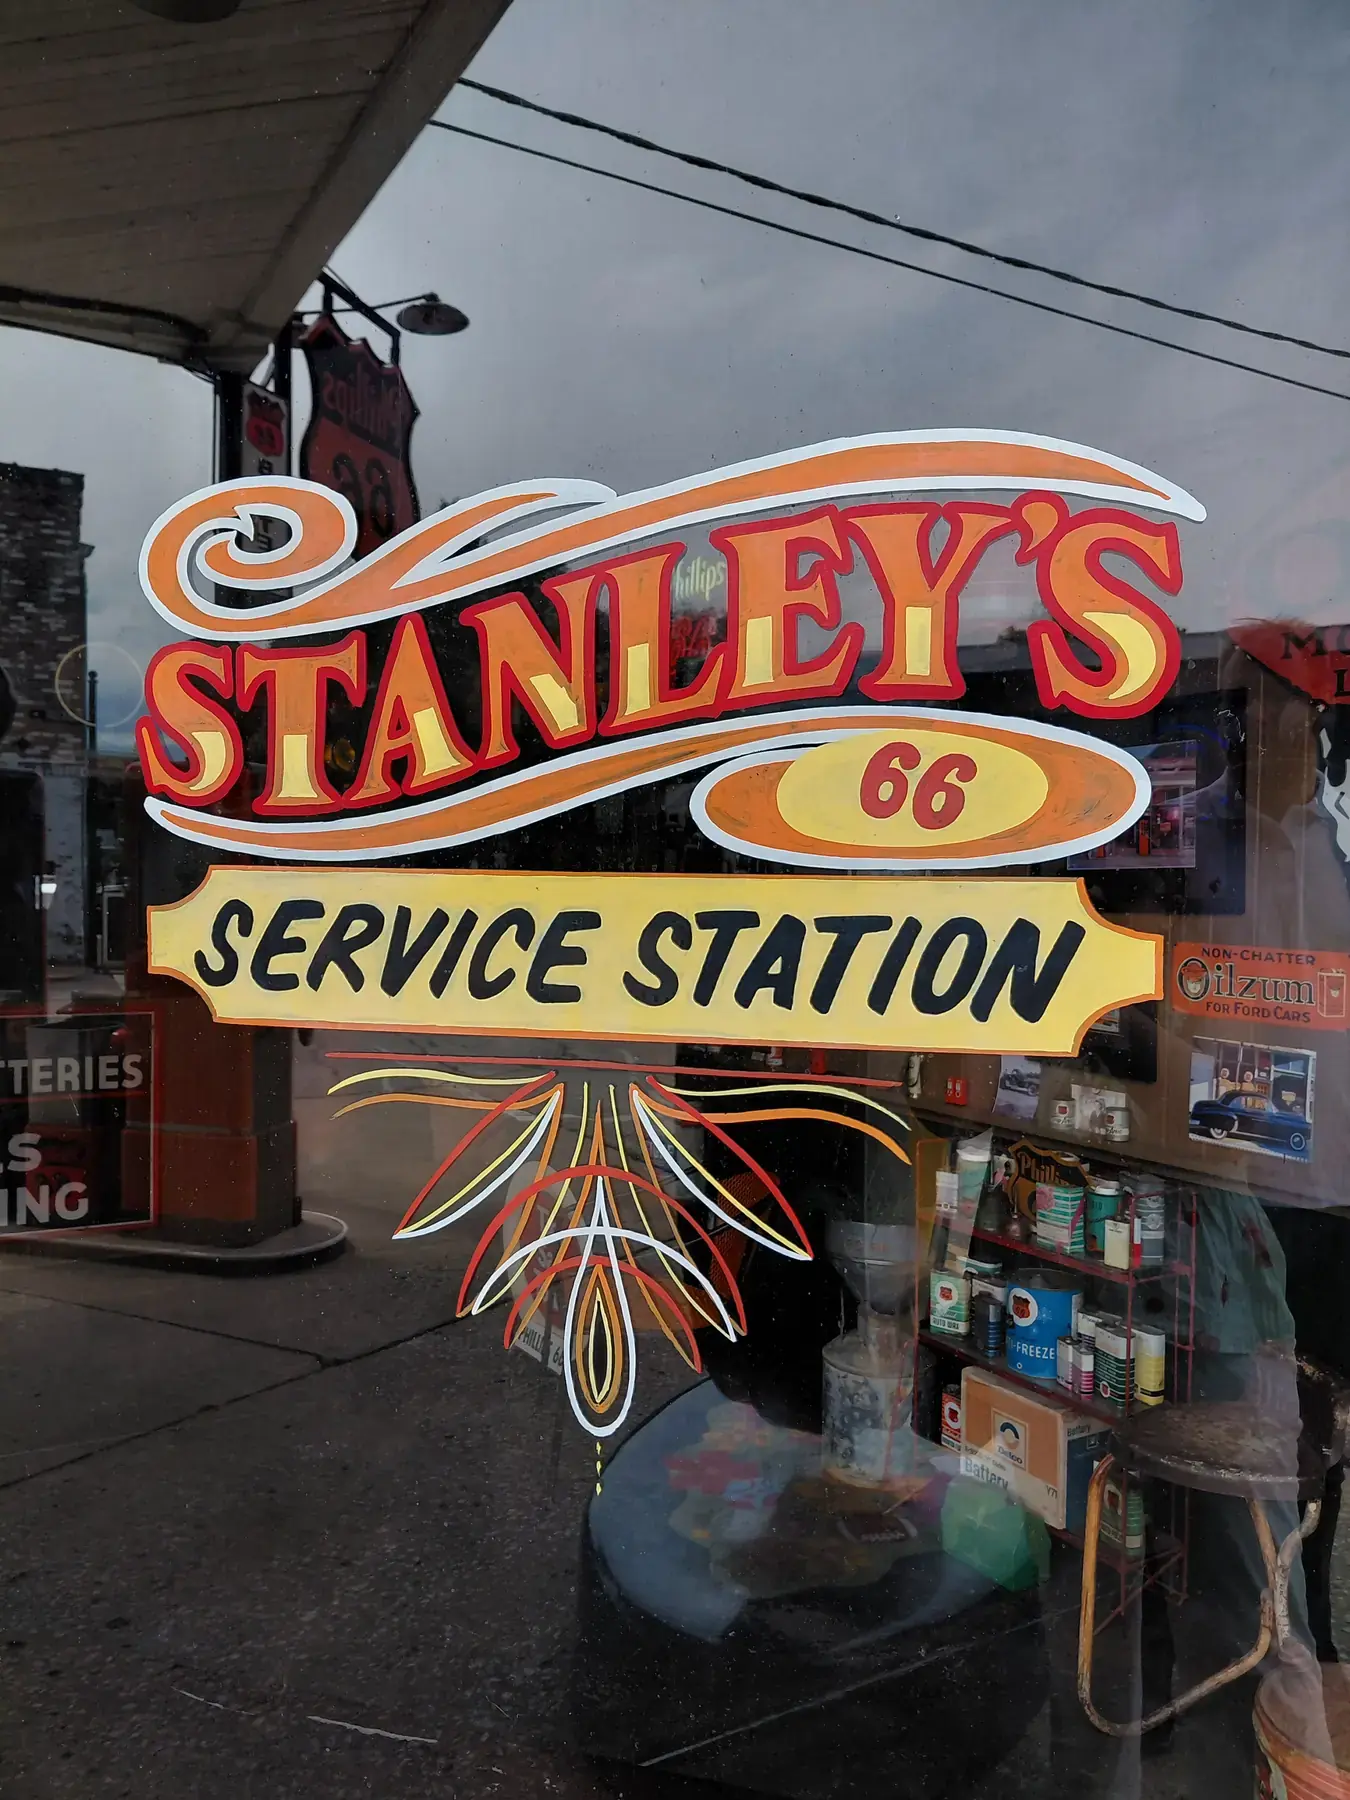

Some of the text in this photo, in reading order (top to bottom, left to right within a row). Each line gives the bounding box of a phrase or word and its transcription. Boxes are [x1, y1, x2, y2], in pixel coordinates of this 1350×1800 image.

[674, 556, 727, 601] hillips
[136, 490, 1182, 816] STANLEY'S
[859, 742, 977, 829] 66
[195, 898, 1086, 1024] SERVICE STATION
[1202, 947, 1317, 966] NON-CHATTER
[1177, 957, 1316, 1006] Oilzum
[1206, 1001, 1230, 1014] FOR
[965, 1457, 1009, 1490] Battery
